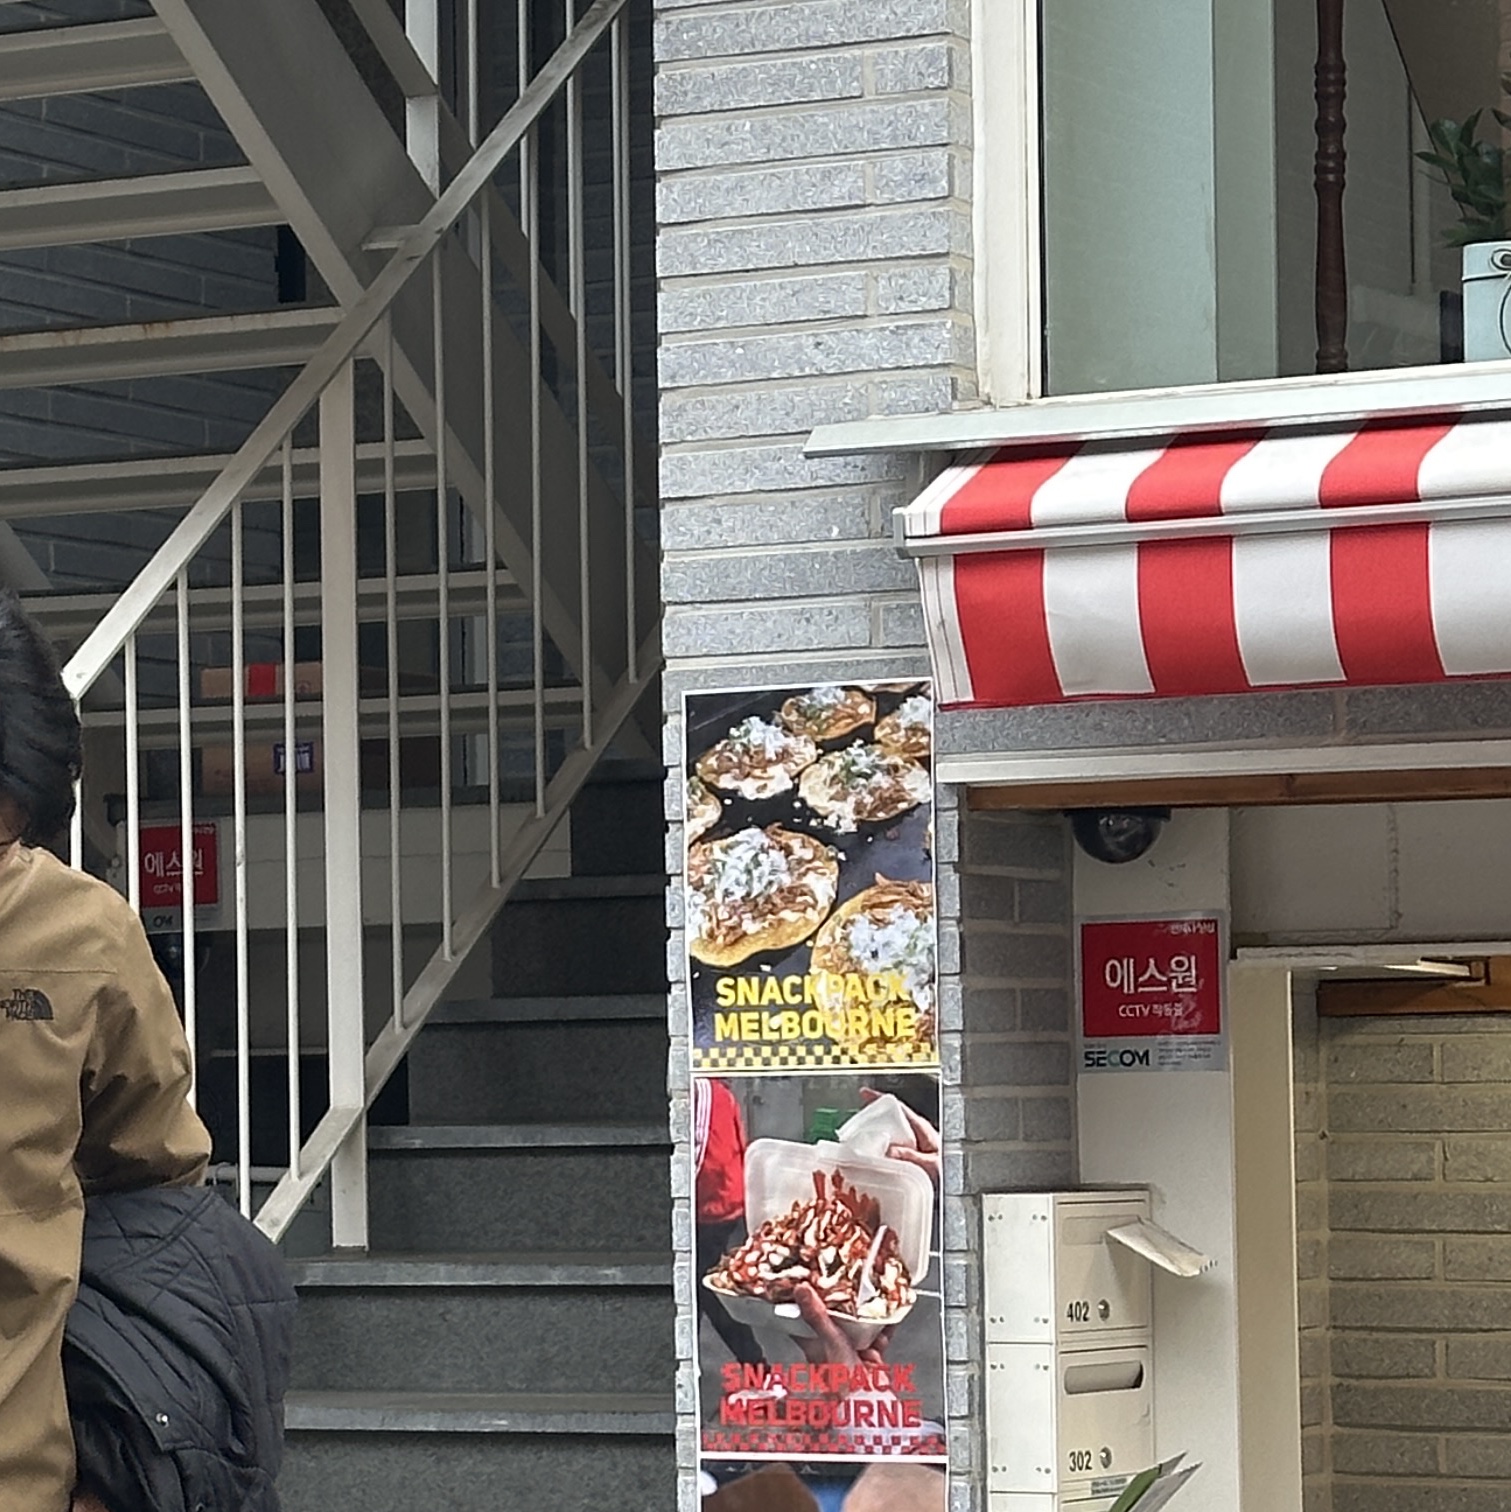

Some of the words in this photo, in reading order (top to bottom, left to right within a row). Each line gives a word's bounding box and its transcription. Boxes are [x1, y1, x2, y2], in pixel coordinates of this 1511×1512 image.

[715, 972, 912, 1007] SNACKPACK
[1105, 955, 1198, 995] 에스원
[714, 1007, 917, 1042] MELBOURNE
[1118, 1004, 1151, 1018] CCTV
[1084, 1049, 1150, 1068] SECOM
[1067, 1301, 1090, 1323] 402
[720, 1362, 918, 1393] SNACKPACK
[719, 1397, 923, 1428] MELBOURNE
[1069, 1450, 1093, 1472] 302
